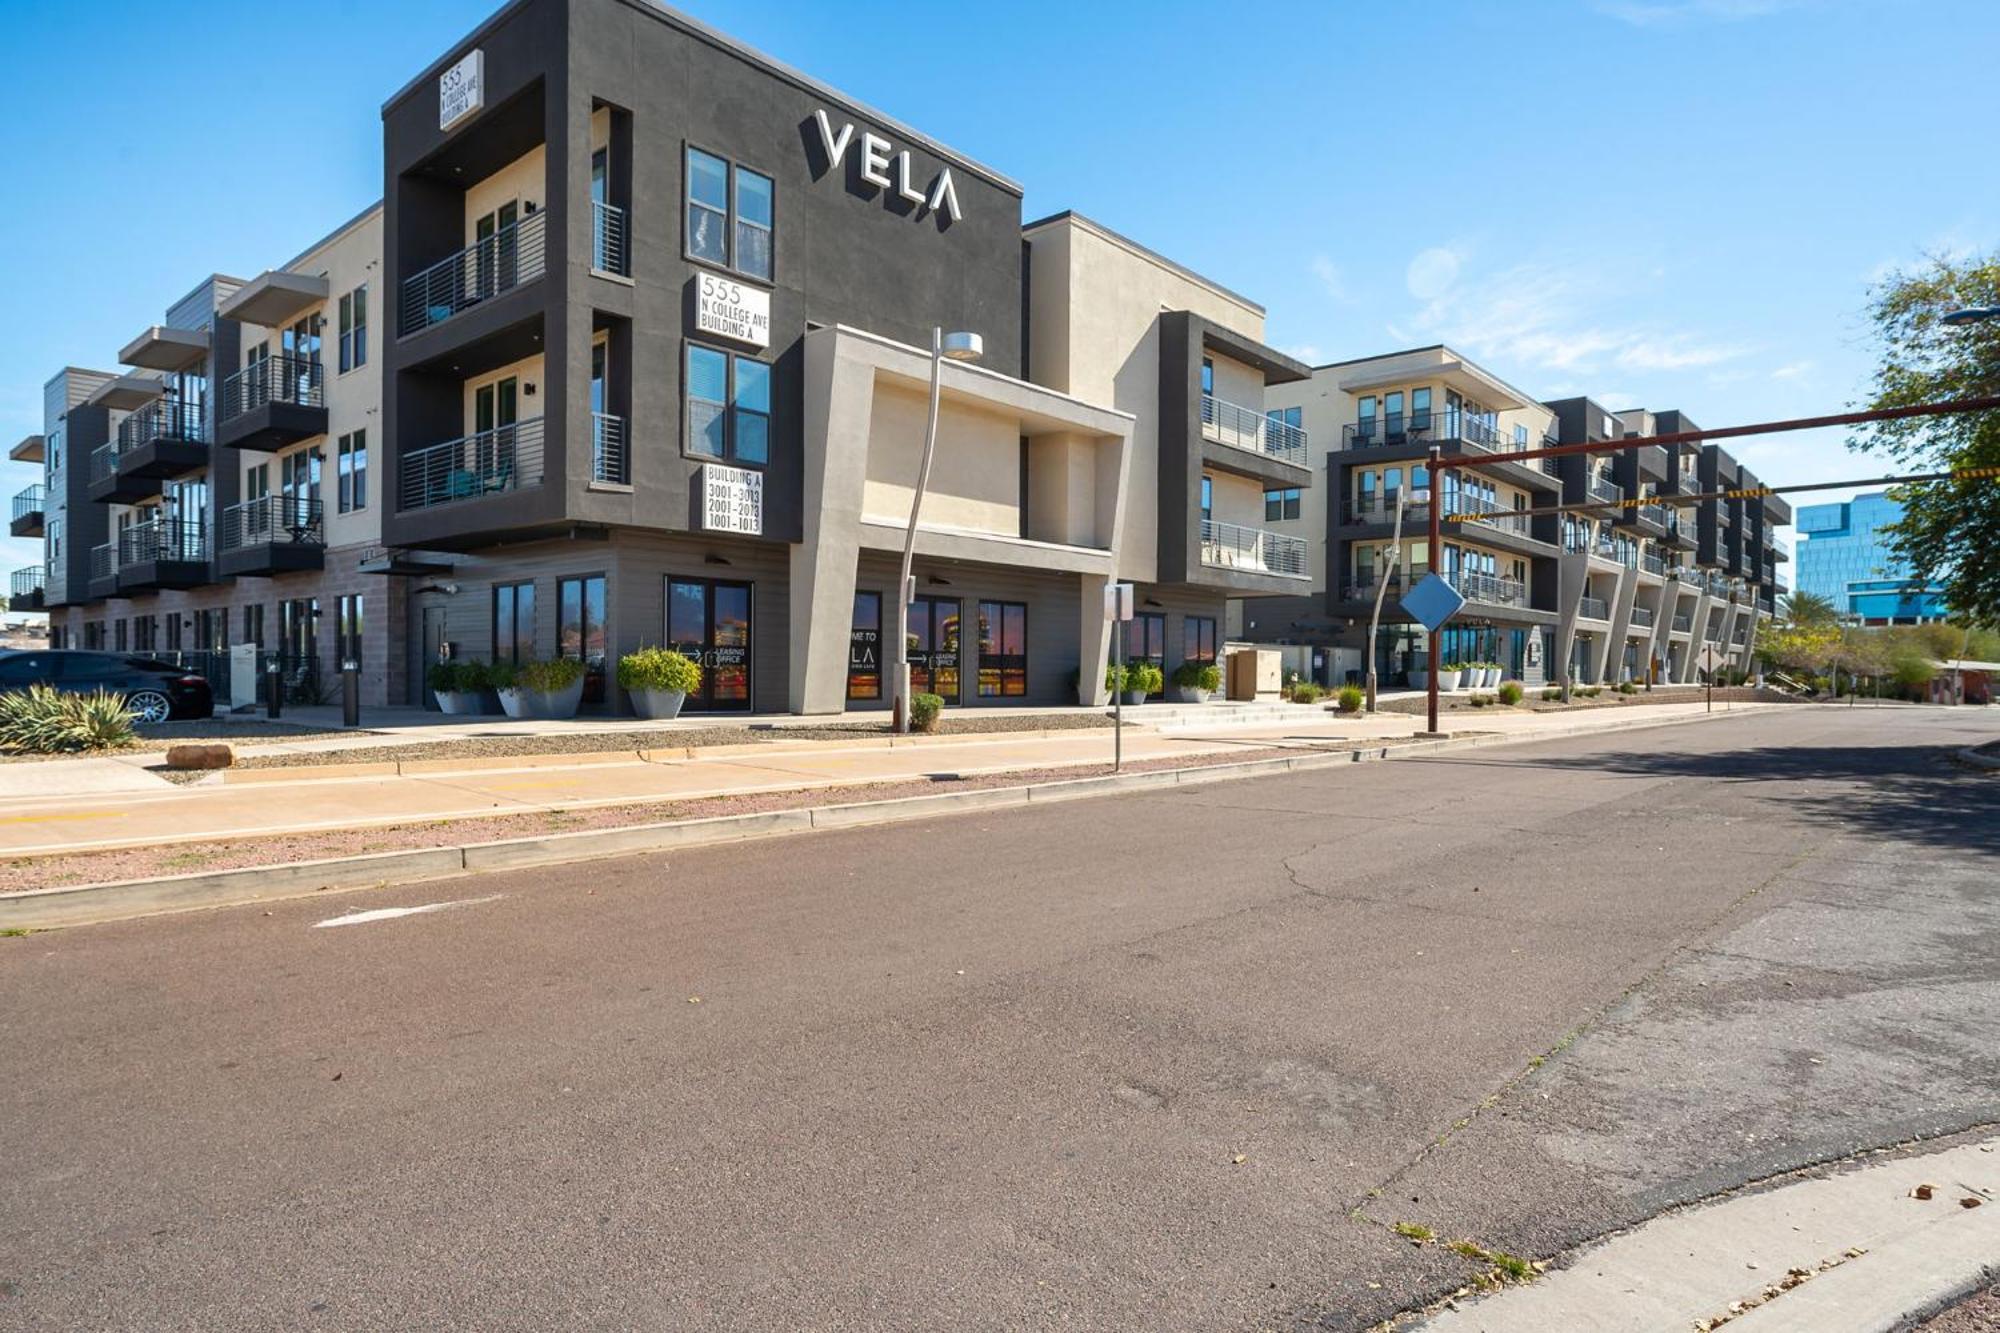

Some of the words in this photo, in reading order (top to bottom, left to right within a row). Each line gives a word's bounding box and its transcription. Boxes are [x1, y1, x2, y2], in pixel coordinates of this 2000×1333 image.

[442, 65, 461, 96] 555
[815, 109, 962, 221] VELA
[703, 277, 741, 305] 555
[702, 298, 708, 311] N
[712, 301, 750, 324] COLLEGE
[752, 313, 768, 329] AVE
[702, 314, 745, 337] BUILDING
[747, 327, 753, 340] A
[709, 467, 752, 486] BUILDING
[755, 474, 761, 487] A
[709, 484, 760, 504] 3001-3013
[709, 498, 760, 518] 2001-2013
[710, 513, 759, 532] 1001-1013
[865, 632, 876, 642] TO
